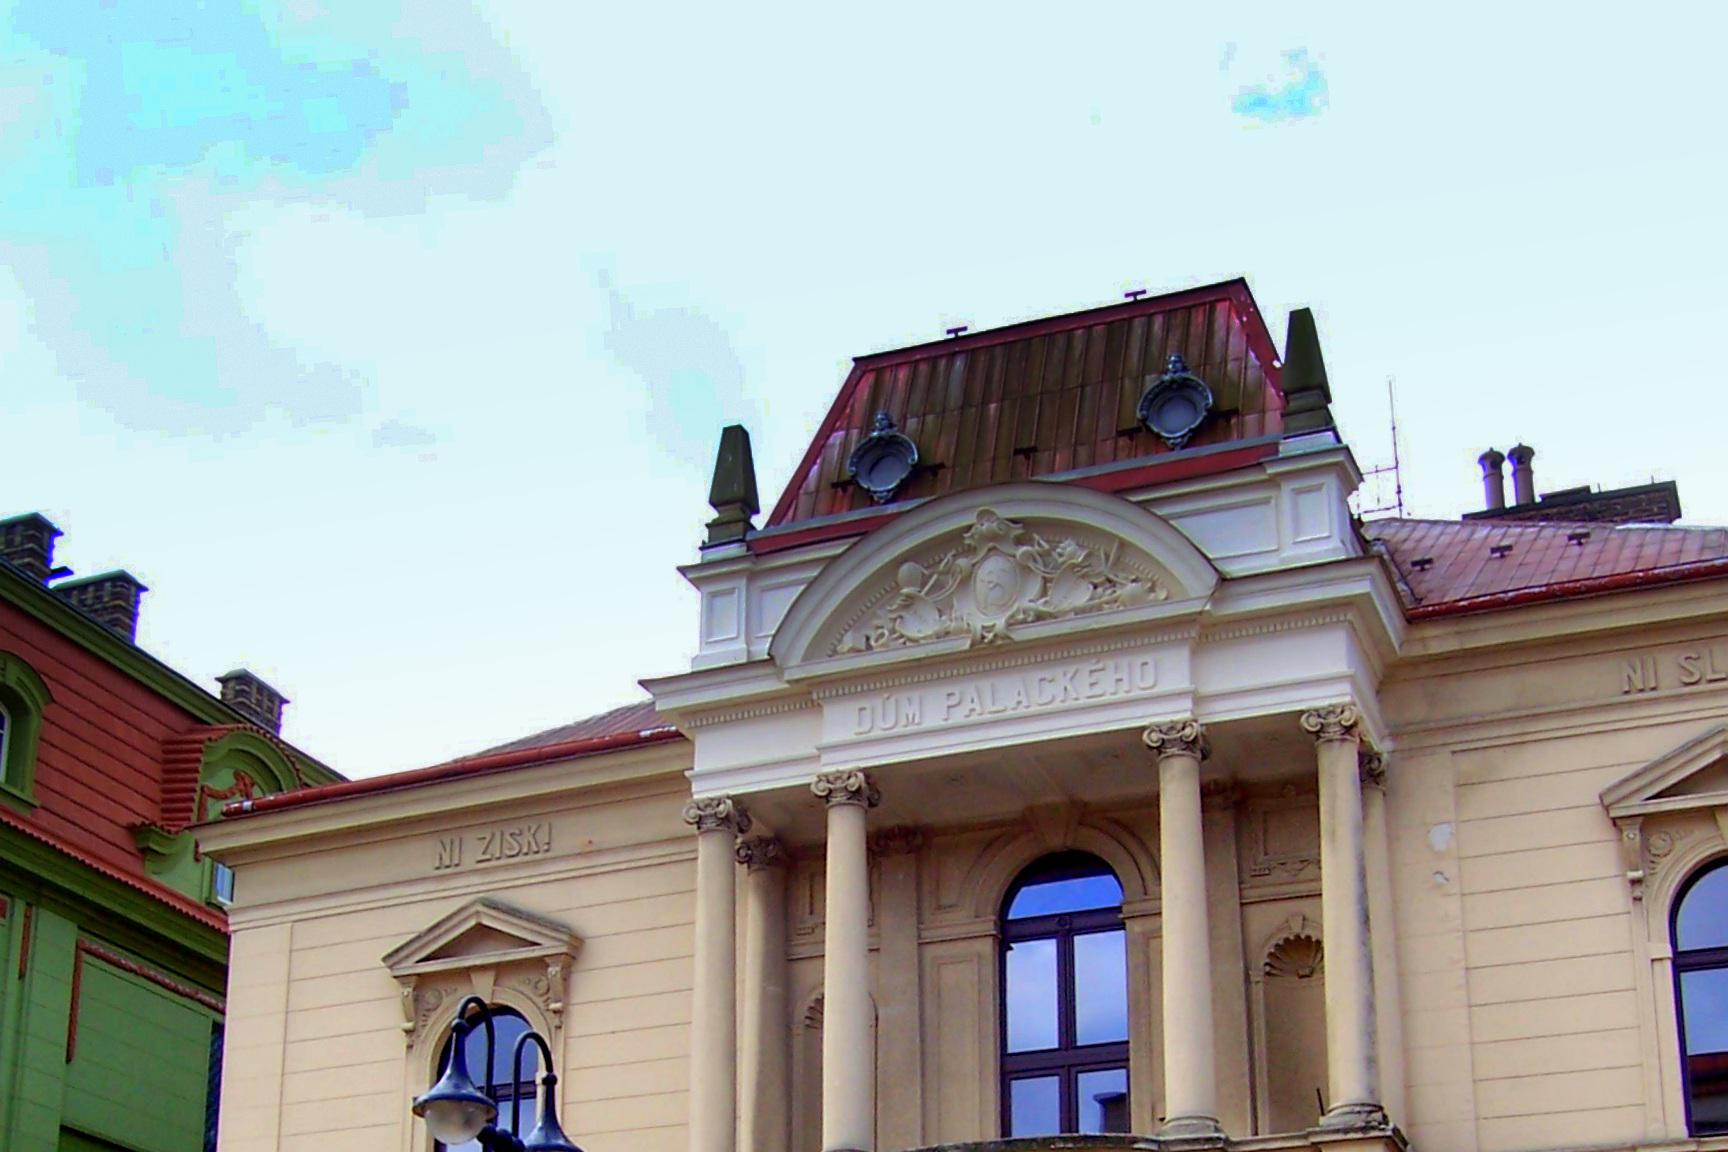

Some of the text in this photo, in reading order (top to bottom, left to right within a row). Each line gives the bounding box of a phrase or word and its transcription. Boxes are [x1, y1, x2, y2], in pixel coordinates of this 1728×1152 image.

[941, 658, 1159, 722] PALACKÉHO
[1621, 655, 1659, 694] NI
[434, 821, 553, 871] NI ZISK!
